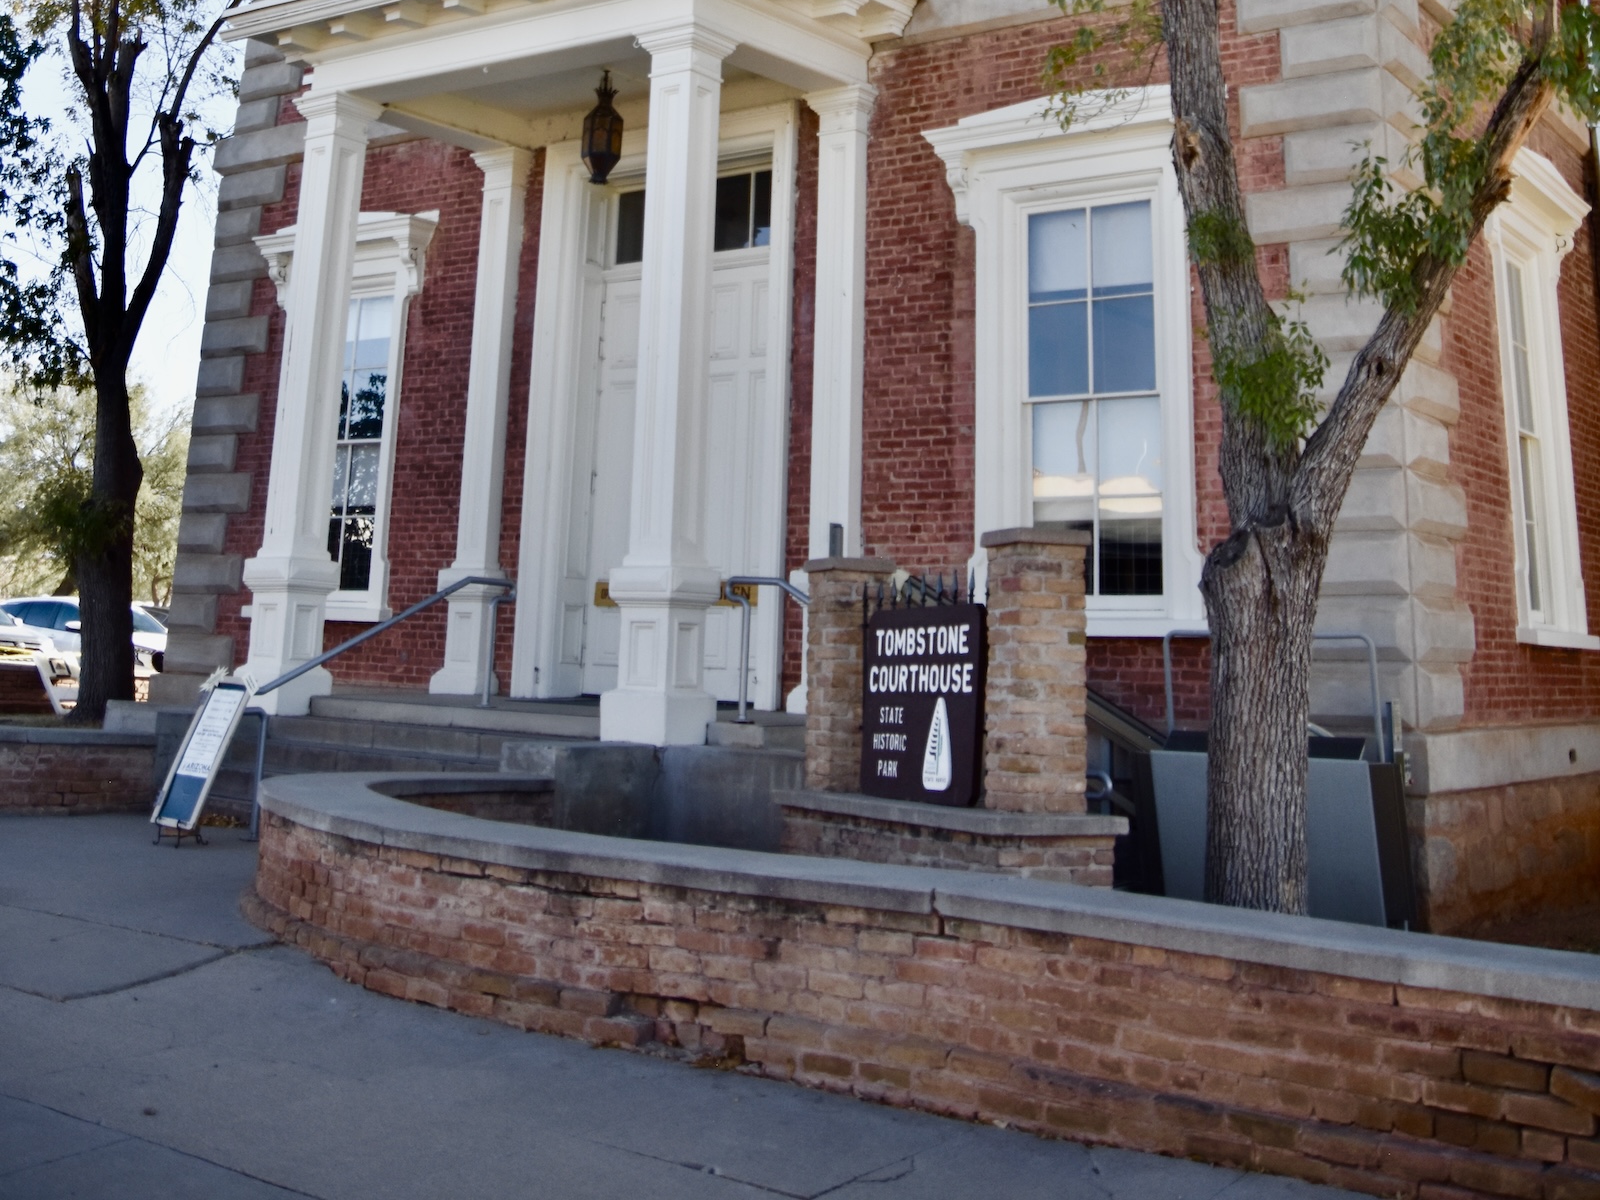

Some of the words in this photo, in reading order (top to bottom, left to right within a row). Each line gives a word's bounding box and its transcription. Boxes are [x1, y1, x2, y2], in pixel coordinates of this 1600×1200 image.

[876, 624, 970, 657] TOMBSTONE
[869, 663, 974, 694] COURTHOUSE
[879, 706, 904, 724] STATE
[872, 733, 907, 752] HISTORIC
[877, 760, 898, 778] PARK
